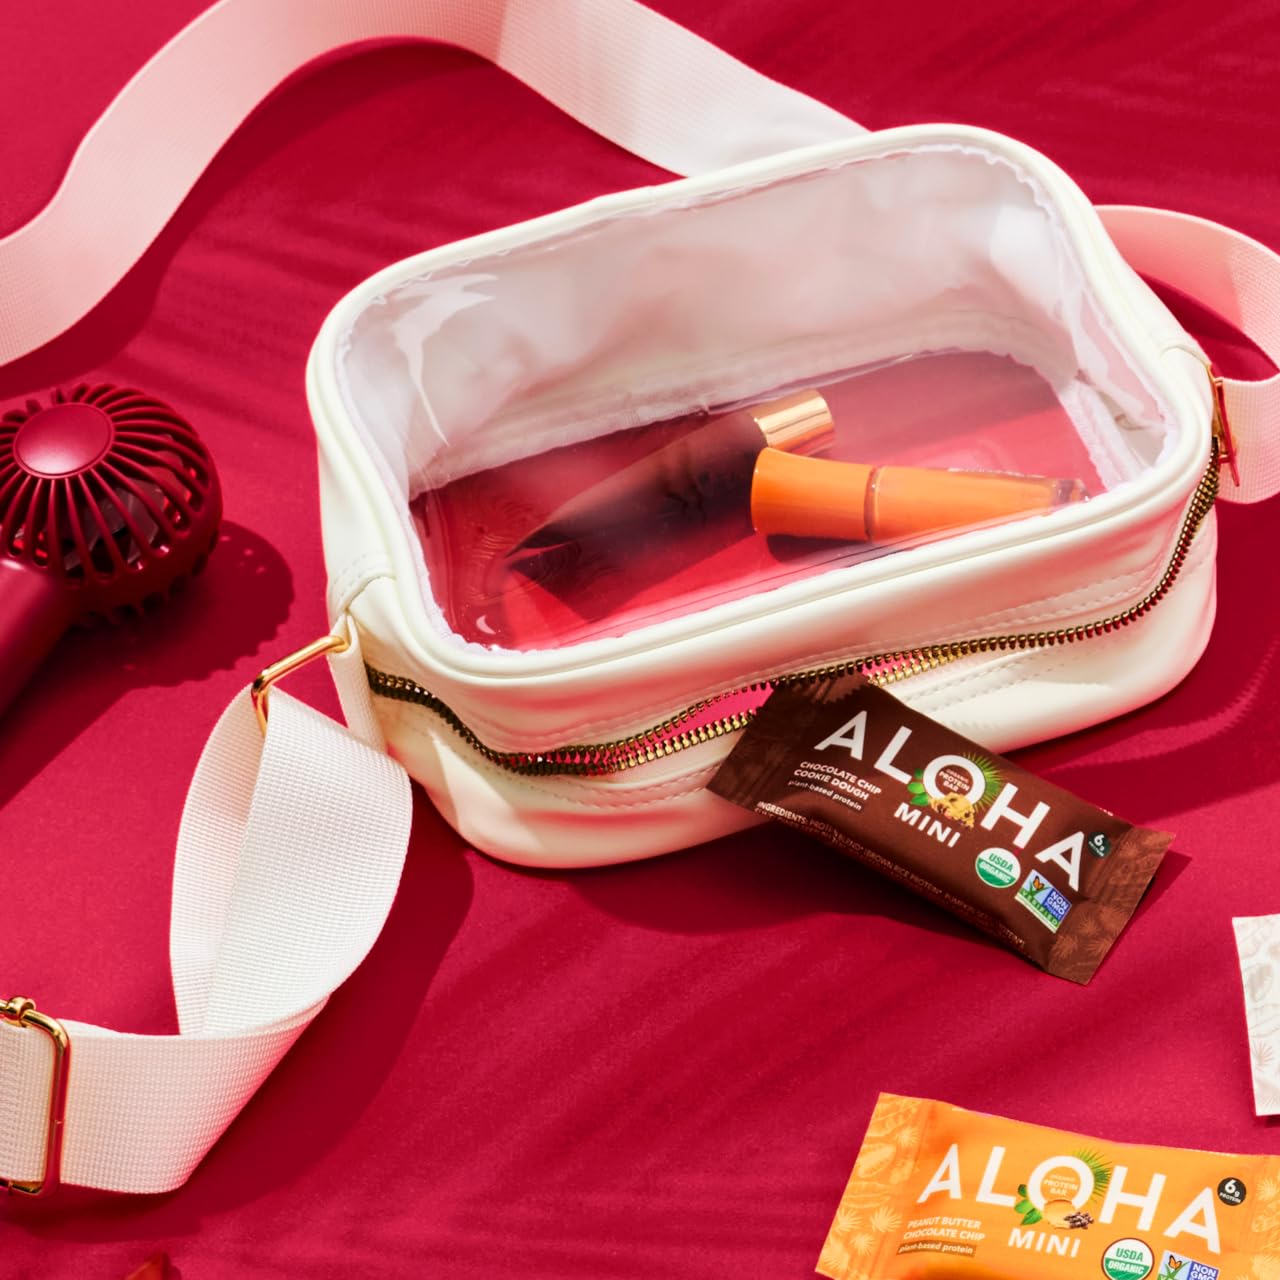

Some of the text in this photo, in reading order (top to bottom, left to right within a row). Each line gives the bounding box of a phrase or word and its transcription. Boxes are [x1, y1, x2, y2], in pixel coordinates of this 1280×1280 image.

[794, 769, 869, 800] COOKIE DOUGH
[800, 762, 882, 794] CHOCOLATE CHIP
[788, 780, 861, 811] plant-based protein
[814, 710, 1085, 891] ALOHA
[757, 802, 808, 824] INGREDIENTS:
[894, 802, 960, 848] MINI
[989, 853, 1014, 872] USDA
[1047, 897, 1065, 915] GMO
[1052, 891, 1069, 909] NON
[1219, 1192, 1241, 1204] PROTEIN
[1224, 1179, 1240, 1198] 6g
[916, 1143, 1221, 1254] ALOHA
[907, 1216, 983, 1230] PEANUT BUTTER
[904, 1228, 986, 1241] CHOCOLATE CHIP
[1008, 1227, 1081, 1257] MINI
[899, 1243, 973, 1254] plant-based protein
[1115, 1247, 1144, 1262] USDA
[1108, 1261, 1145, 1275] ORGANIC
[1192, 1264, 1217, 1276] NON
